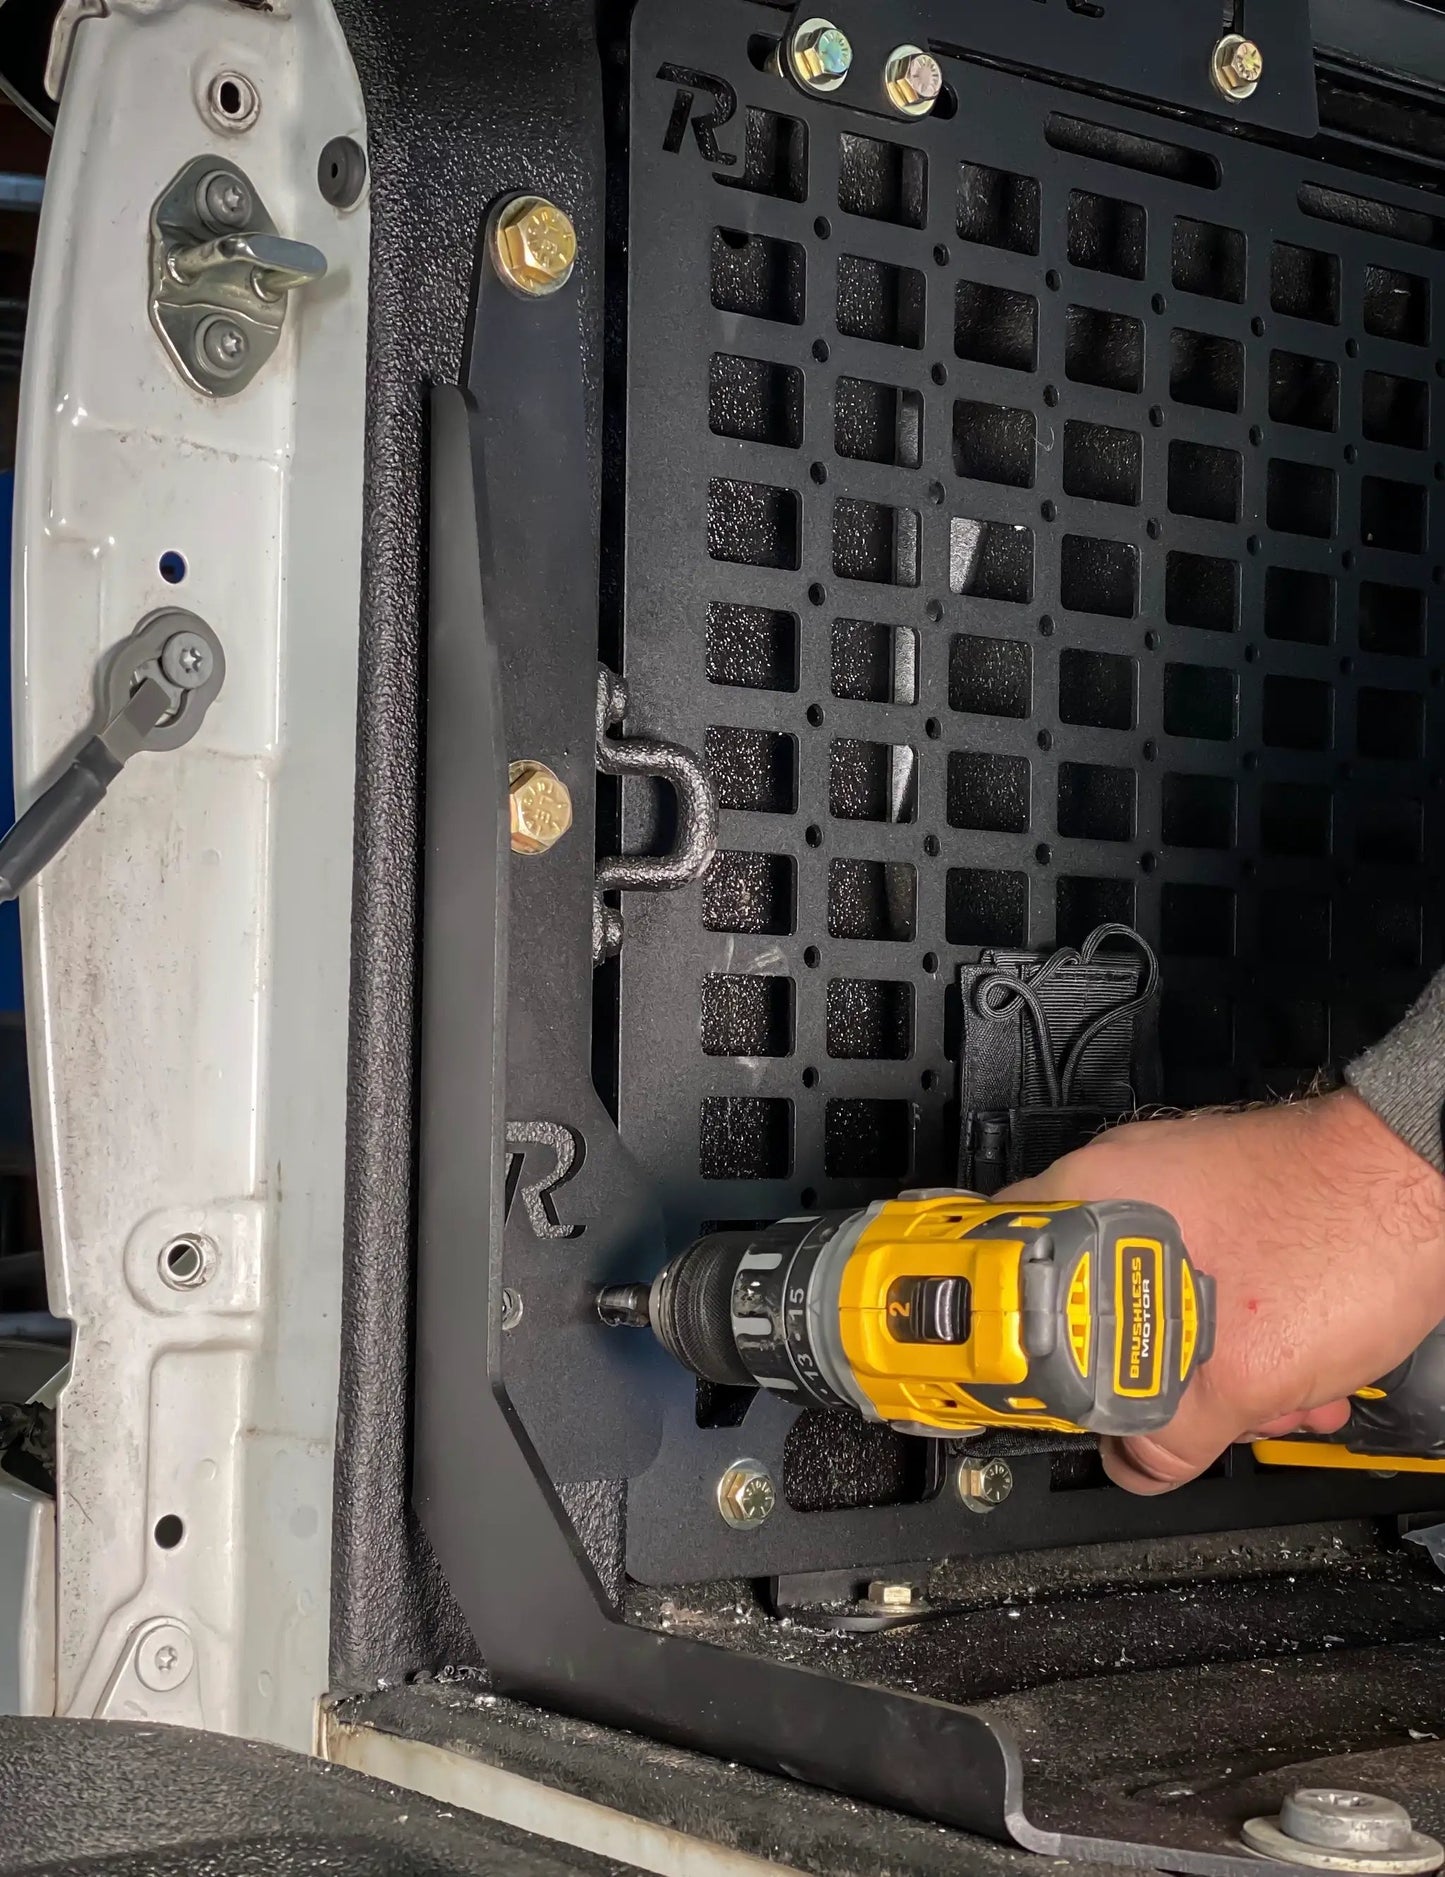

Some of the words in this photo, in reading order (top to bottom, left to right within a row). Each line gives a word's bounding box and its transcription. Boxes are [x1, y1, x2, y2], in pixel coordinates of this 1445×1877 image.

[788, 1287, 805, 1321] 15
[889, 1301, 911, 1318] 2
[1129, 1256, 1143, 1379] BRUSHLESS
[1141, 1279, 1151, 1358] MOTOR
[797, 1353, 819, 1381] 13
